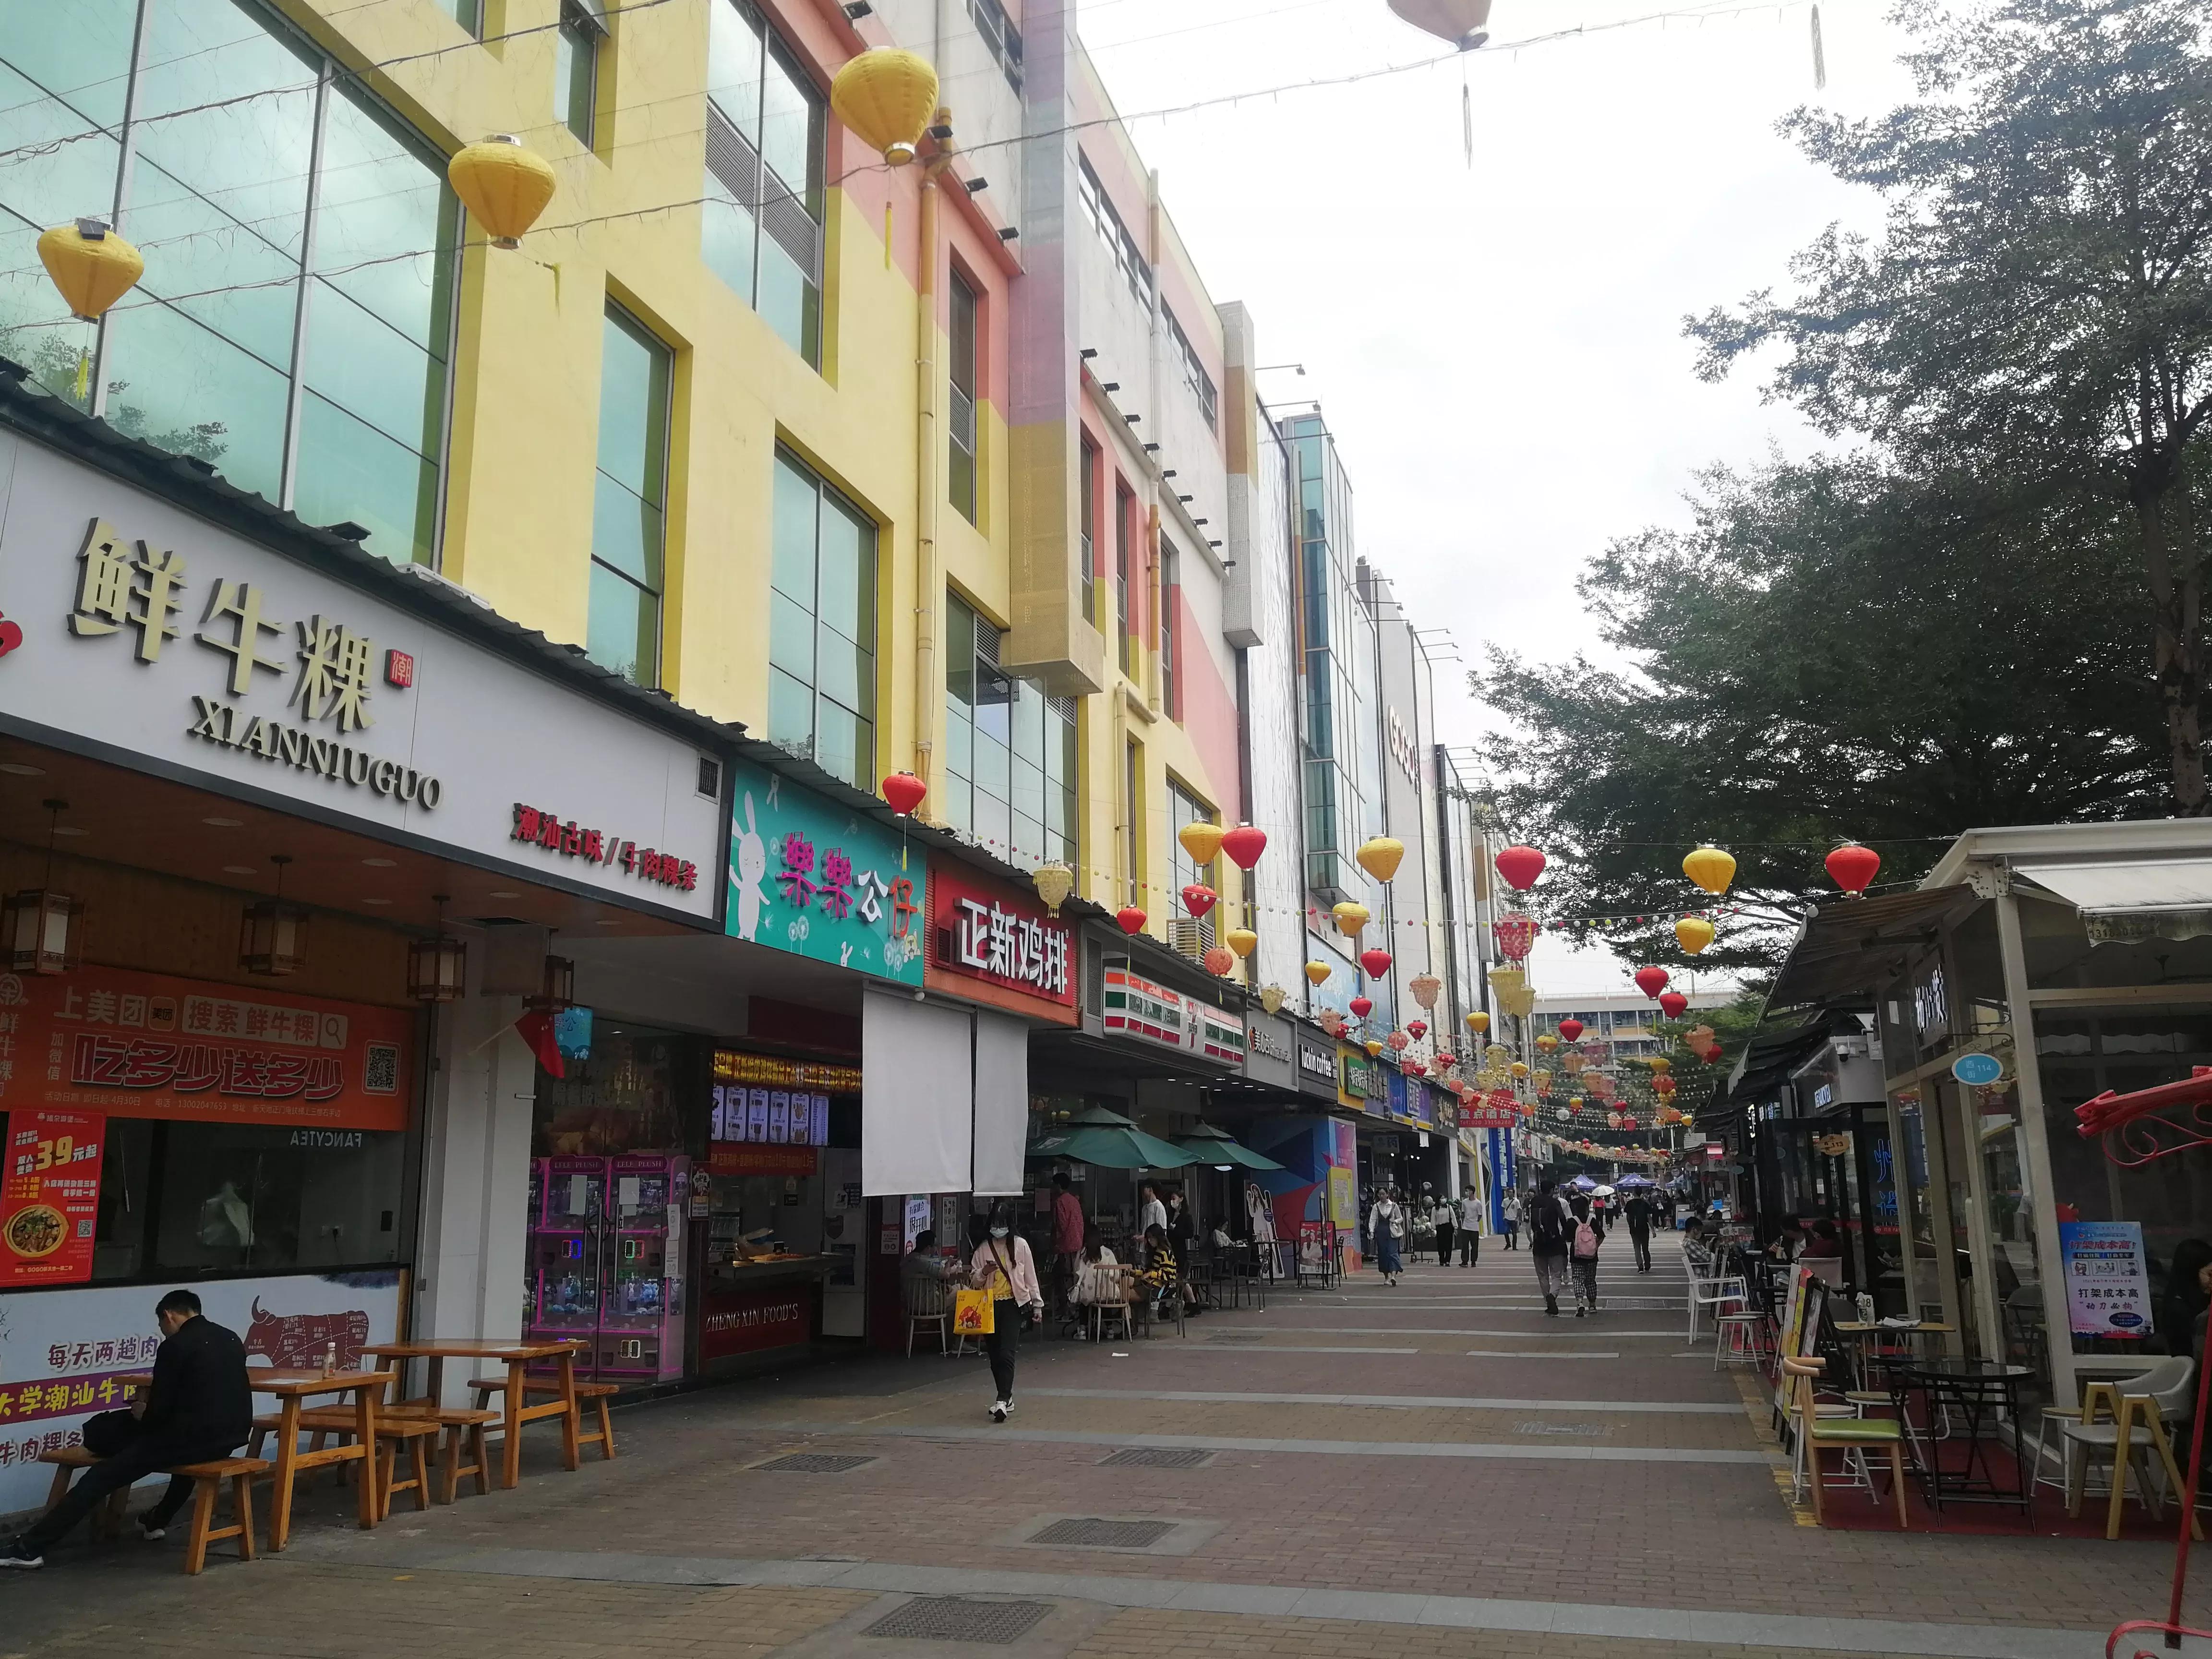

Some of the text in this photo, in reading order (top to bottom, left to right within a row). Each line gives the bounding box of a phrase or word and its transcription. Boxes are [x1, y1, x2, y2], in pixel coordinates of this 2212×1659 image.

[67, 517, 376, 733] 鲜牛粿
[187, 696, 445, 811] XIANNIUGUO
[511, 803, 698, 891] 潮汕古味/牛肉粿条
[959, 897, 1068, 994] 正新鸡排
[53, 986, 146, 1027] 上美团
[152, 1008, 173, 1021] 美团
[189, 1000, 314, 1042] 搜索 鲜牛粿
[48, 1032, 64, 1081] 加微信
[72, 1033, 344, 1100] 吃多少送多少
[1301, 1043, 1316, 1072] luckin
[1317, 1052, 1332, 1077] coffee
[178, 1099, 227, 1110] 13002047653
[36, 1135, 73, 1171] 39
[72, 1144, 97, 1162] 元起
[637, 1160, 661, 1168] PLUSH
[2078, 1288, 2139, 1298] 打架成本高
[706, 1303, 799, 1332] ZHENG XIN FOOD'S
[48, 1336, 158, 1368] 每天两趟肉
